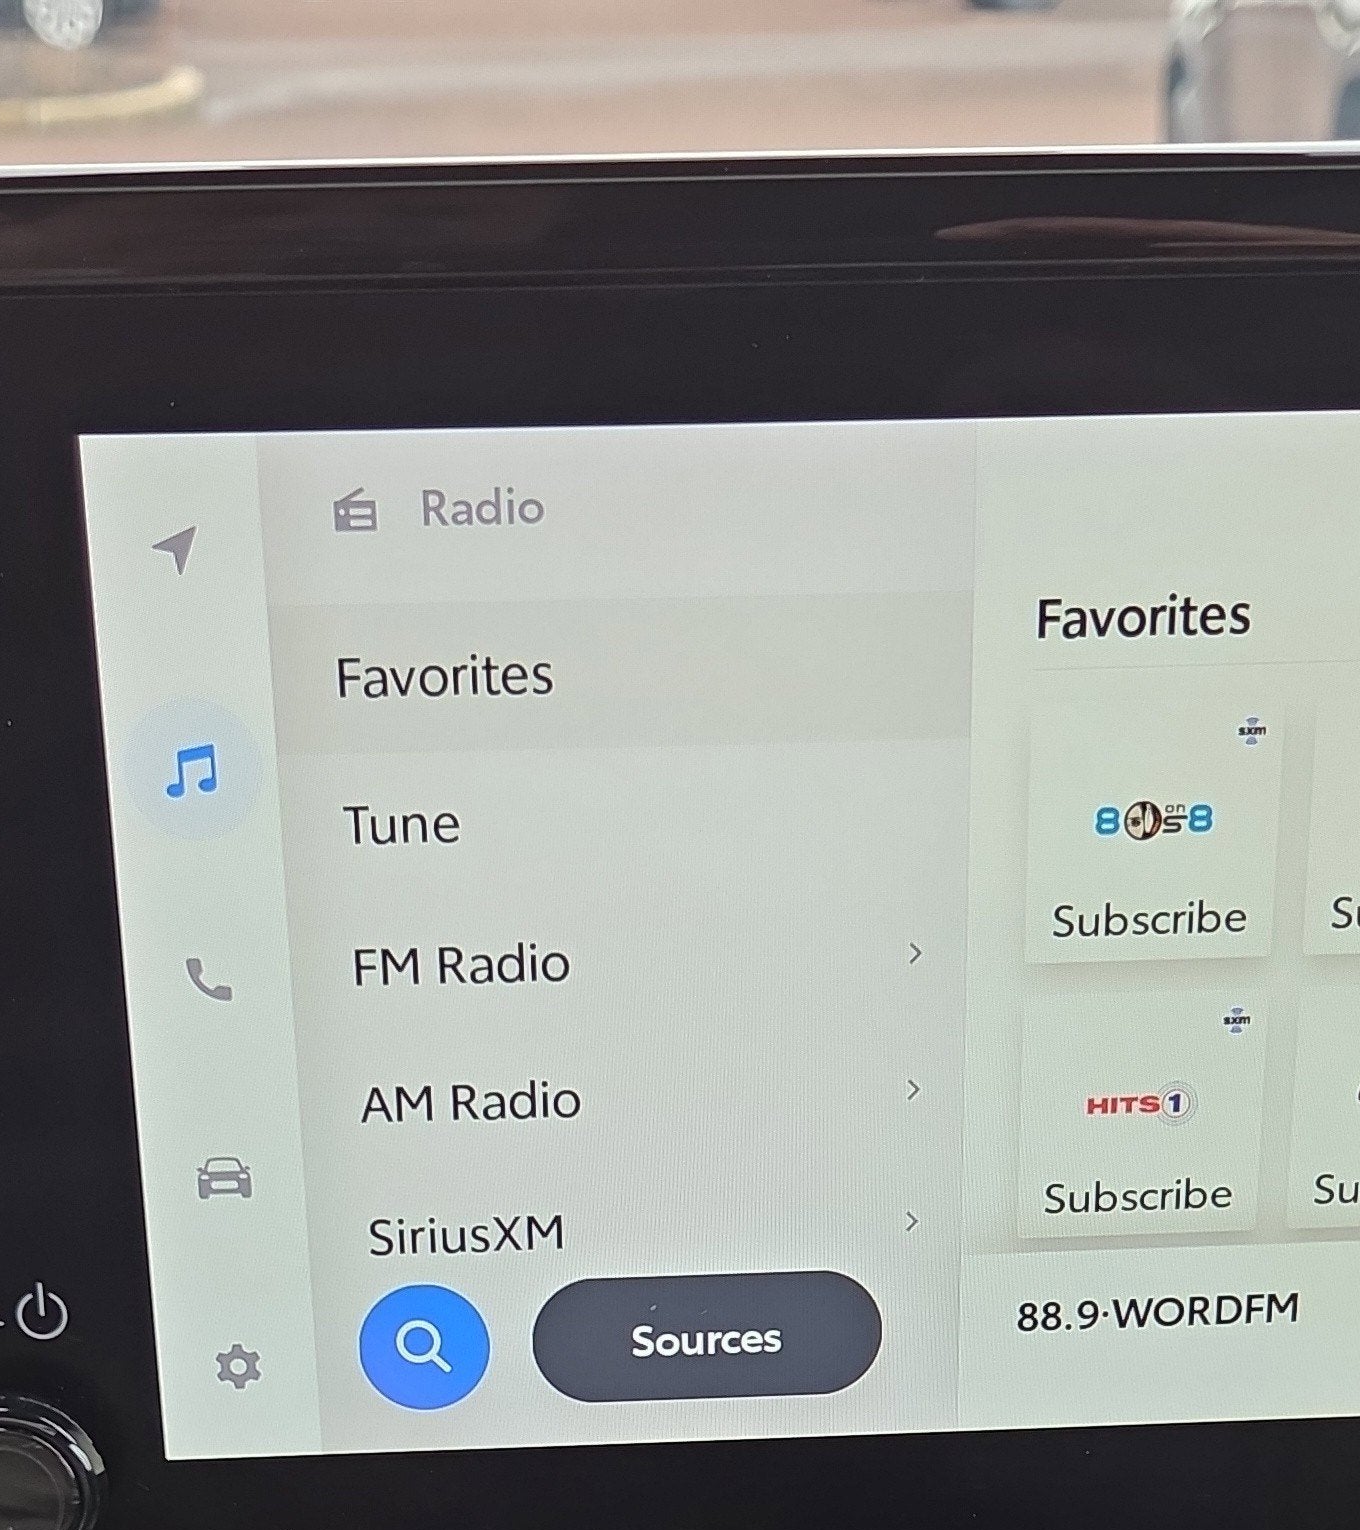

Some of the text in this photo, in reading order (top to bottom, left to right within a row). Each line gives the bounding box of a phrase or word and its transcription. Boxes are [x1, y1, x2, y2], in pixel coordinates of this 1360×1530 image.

[421, 487, 545, 527] Radio
[1036, 593, 1252, 640] Favorites
[337, 653, 555, 700] Favorites
[342, 804, 461, 847] Tune
[1052, 900, 1247, 938] Subscribe
[354, 942, 571, 987] FM Radio
[361, 1079, 582, 1124] AM Radio
[1043, 1178, 1234, 1214] Subscribe
[369, 1214, 565, 1257] SiriusXM
[630, 1325, 782, 1358] Sources
